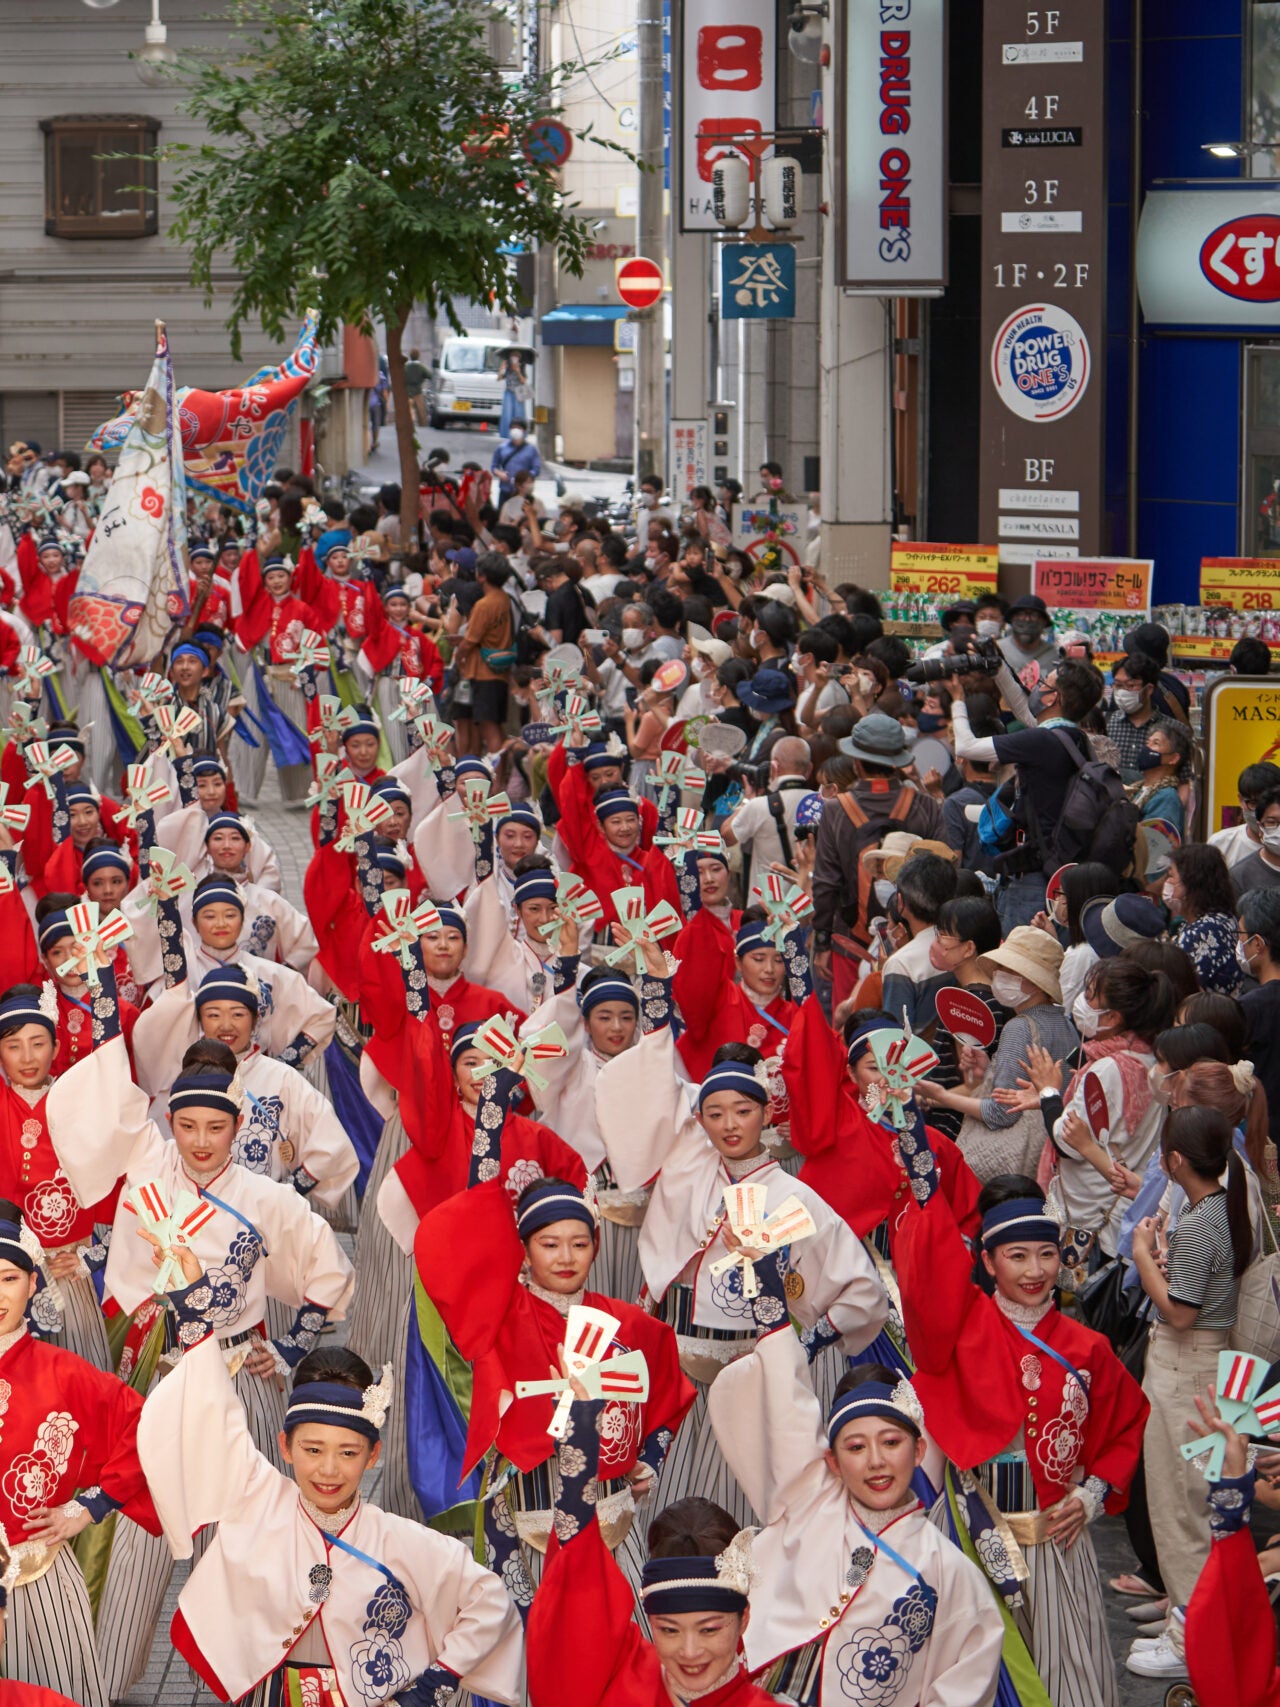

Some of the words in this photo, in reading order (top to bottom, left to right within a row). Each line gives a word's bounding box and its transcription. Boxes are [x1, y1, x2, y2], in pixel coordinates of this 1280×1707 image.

[1026, 11, 1060, 35] 5F
[880, 31, 911, 135] DRUG
[1025, 95, 1059, 119] 4F
[1040, 131, 1075, 144] LUCIA
[1025, 180, 1059, 205] 3F
[1209, 231, 1280, 286] くす
[1014, 330, 1075, 359] POWER
[1014, 350, 1062, 375] DRUG
[1024, 459, 1055, 482] BF
[927, 576, 961, 594] 262
[1242, 592, 1273, 610] 218
[1232, 706, 1280, 721] MAS
